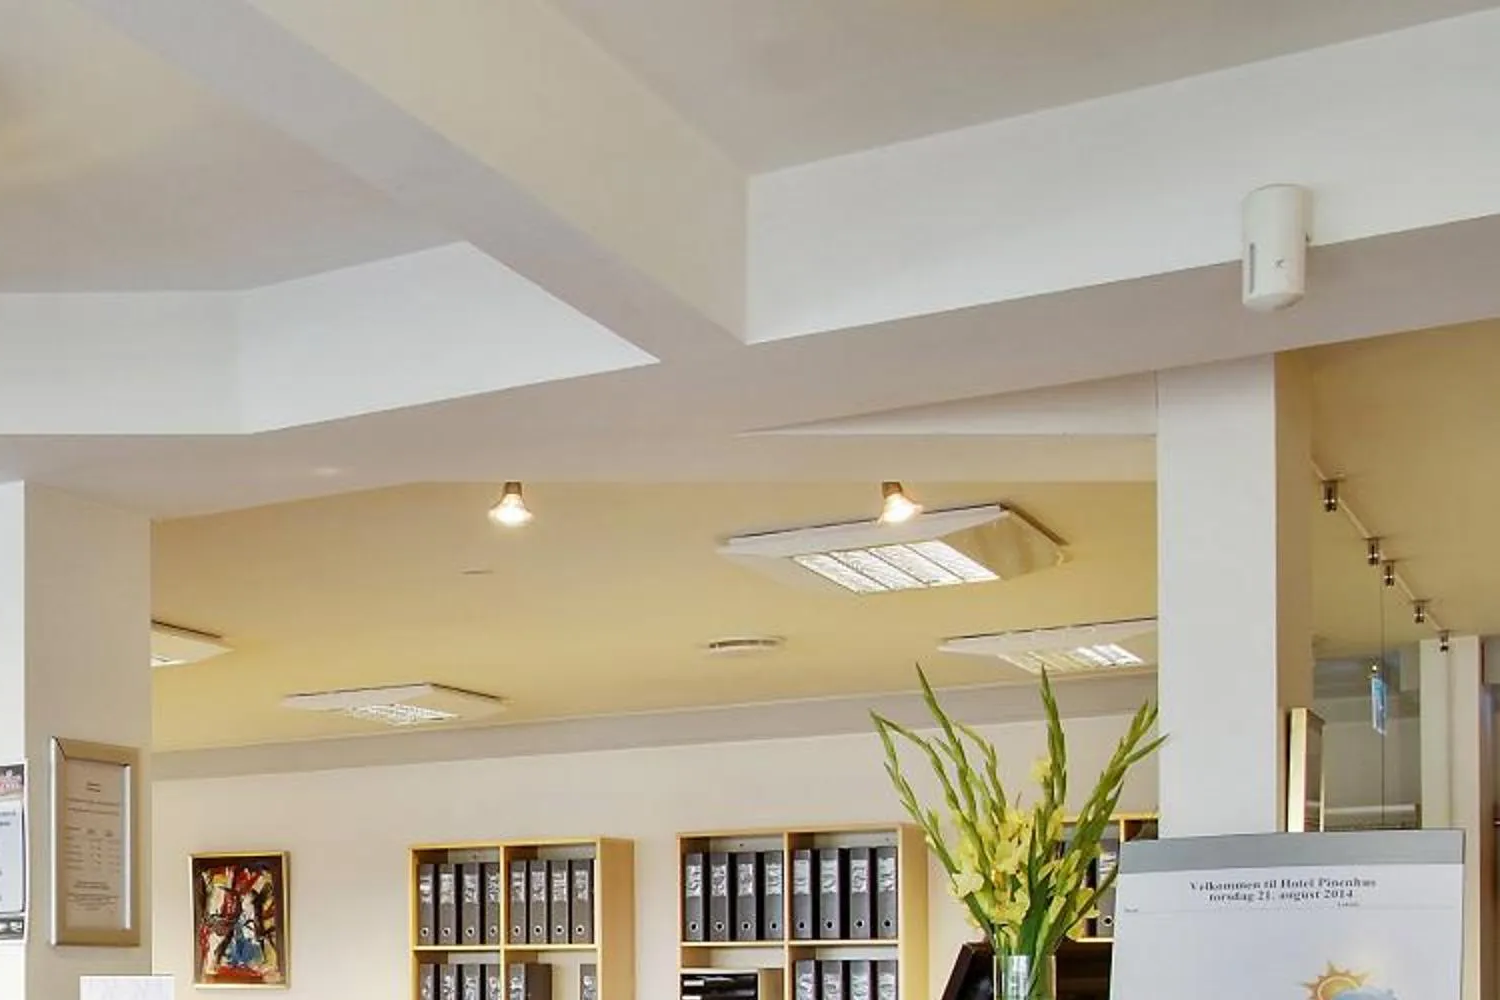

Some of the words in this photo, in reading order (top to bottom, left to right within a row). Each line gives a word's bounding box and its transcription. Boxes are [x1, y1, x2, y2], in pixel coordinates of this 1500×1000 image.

[1264, 880, 1276, 889] til
[1281, 879, 1315, 889] Hotel
[1318, 878, 1376, 889] Pinenhus
[1209, 891, 1254, 902] torsdag
[1280, 891, 1320, 902] august
[1324, 889, 1353, 899] 2014
